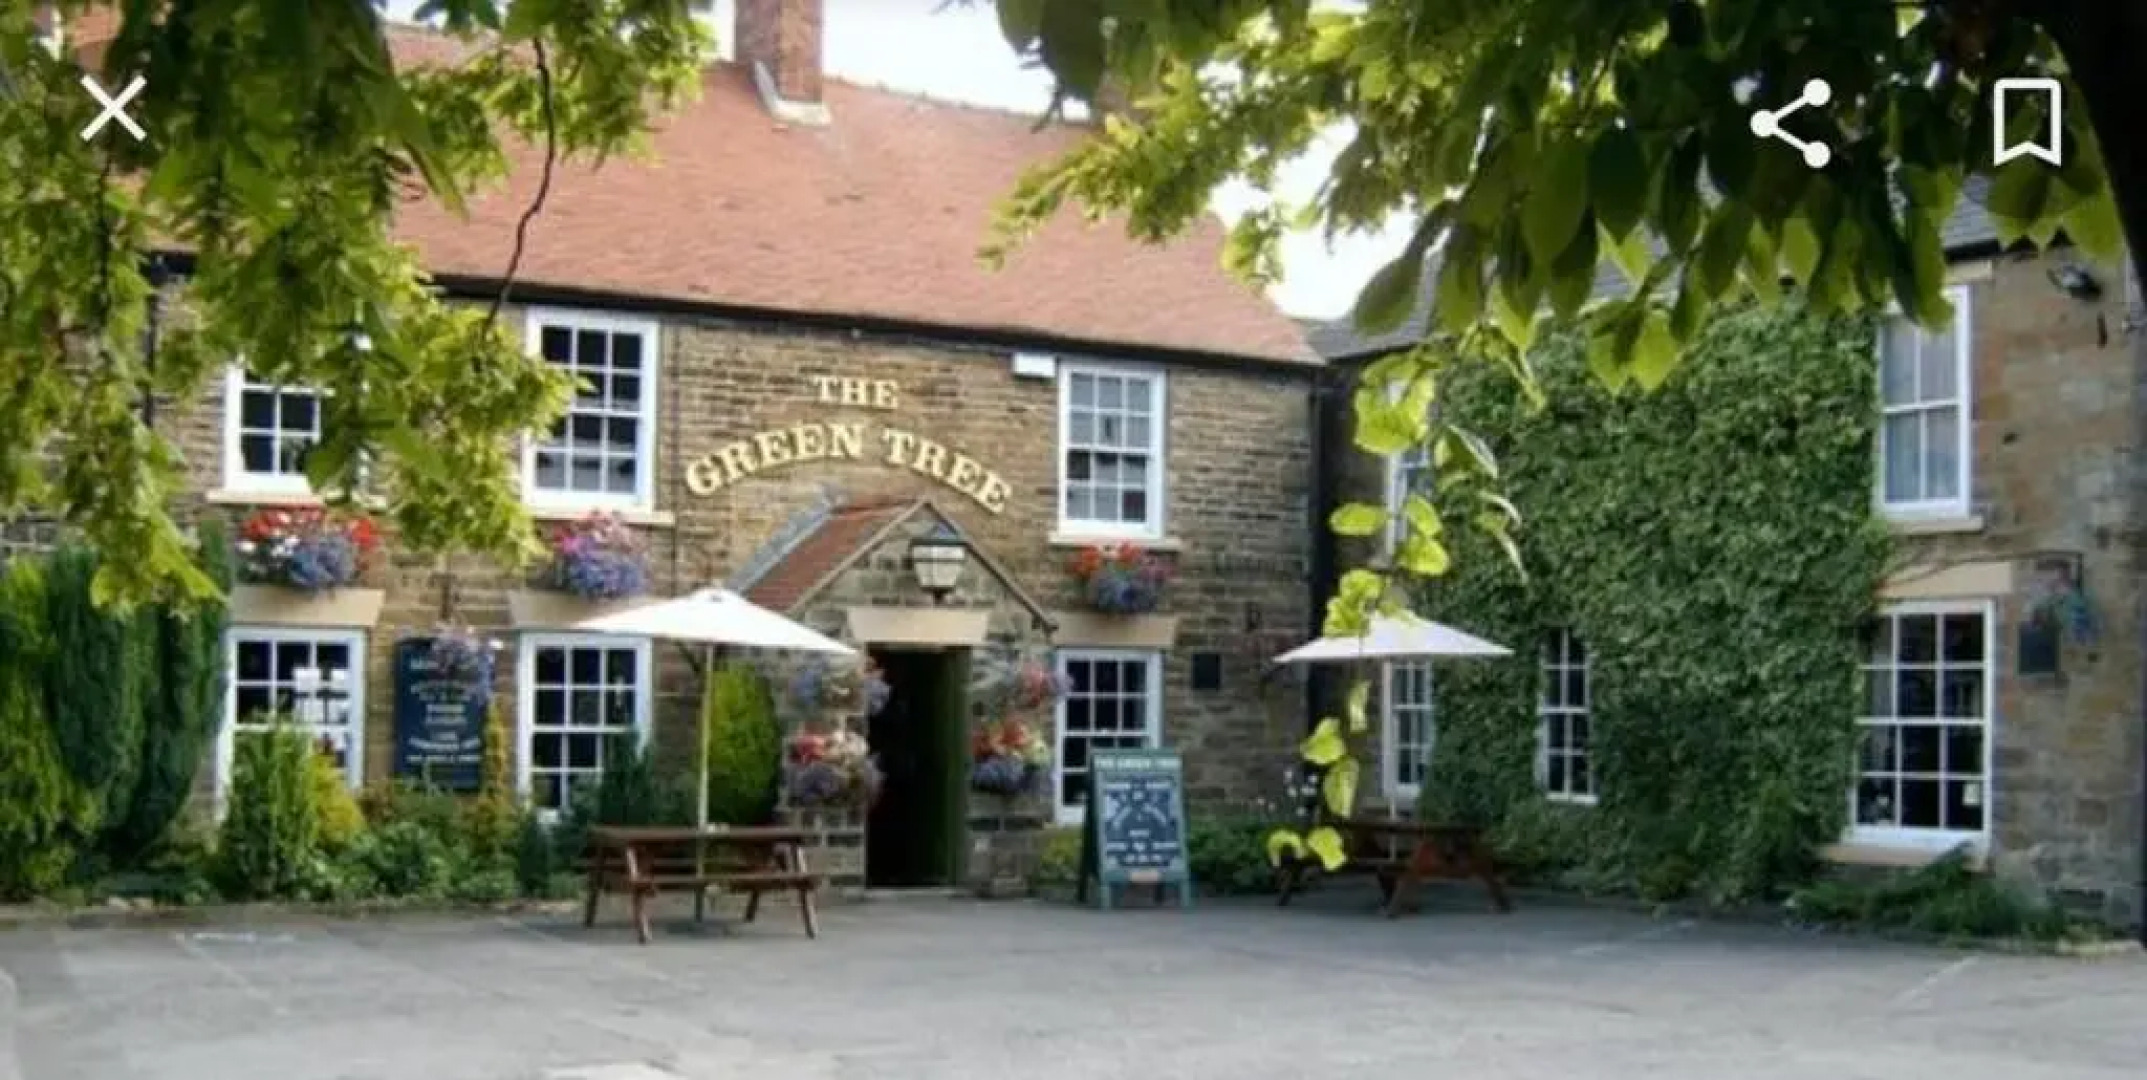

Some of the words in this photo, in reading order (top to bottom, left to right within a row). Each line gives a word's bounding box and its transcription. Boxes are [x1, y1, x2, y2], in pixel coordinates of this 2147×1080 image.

[813, 375, 898, 410] THE
[685, 422, 867, 496] GREEN
[881, 427, 1012, 515] TREE
